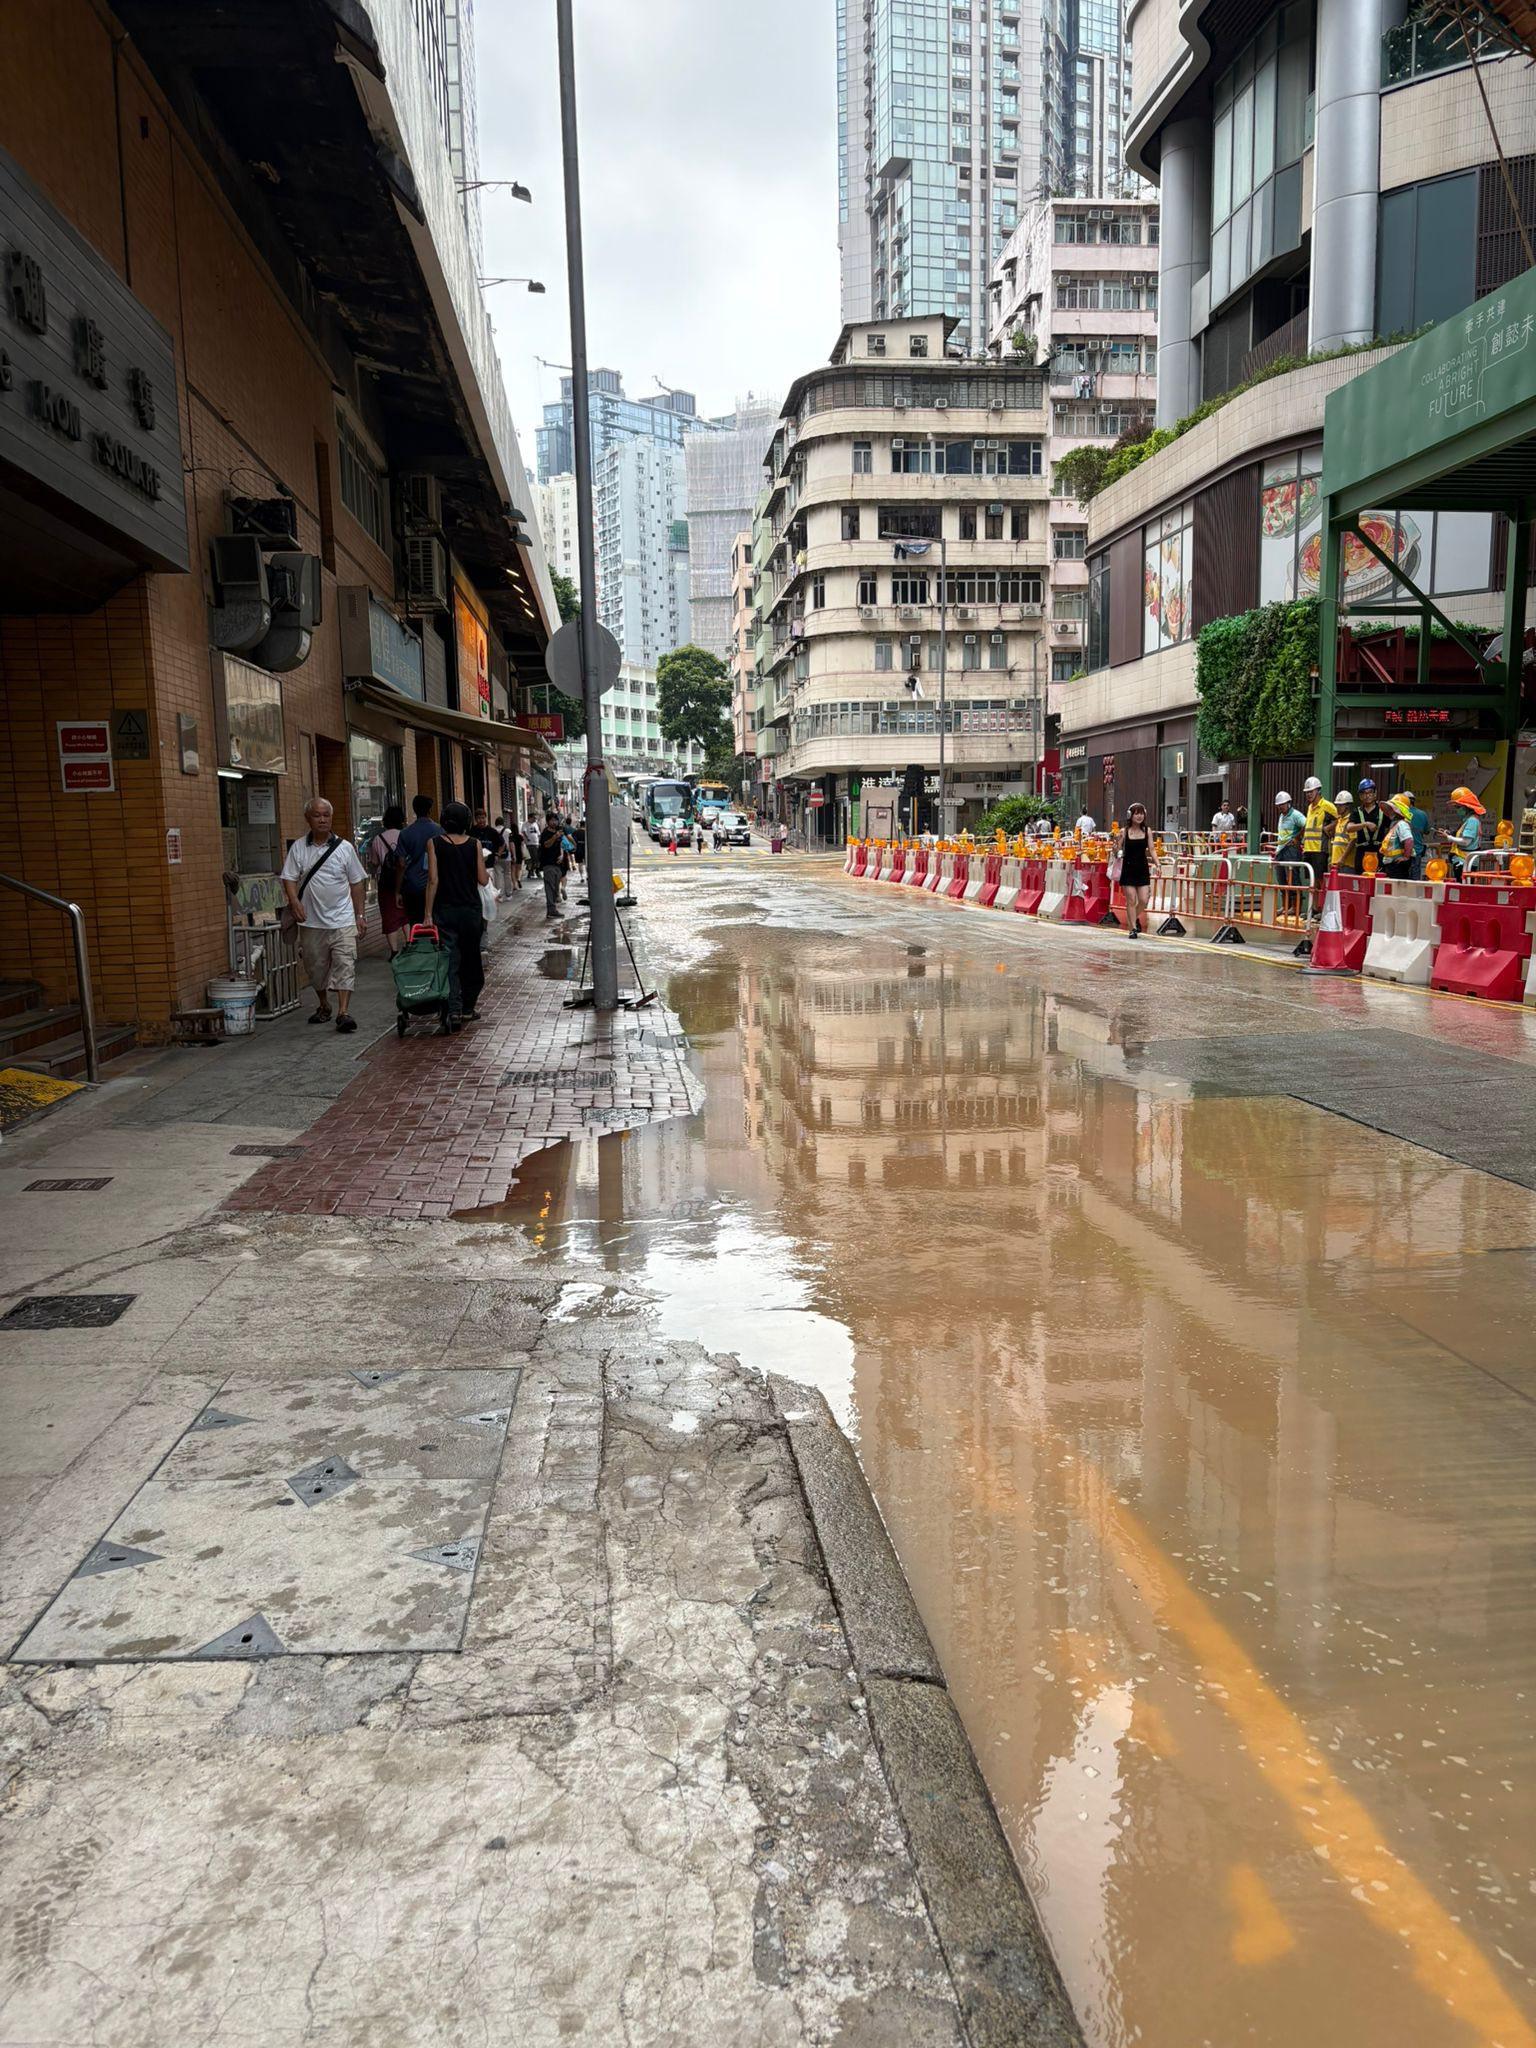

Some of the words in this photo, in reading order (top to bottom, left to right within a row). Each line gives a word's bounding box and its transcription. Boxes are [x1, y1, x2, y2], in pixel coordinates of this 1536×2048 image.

[1422, 345, 1478, 386] COLLABORATING
[1445, 358, 1480, 388] BRIGHT
[1429, 379, 1474, 417] FUTURE
[91, 432, 161, 501] SQUARE
